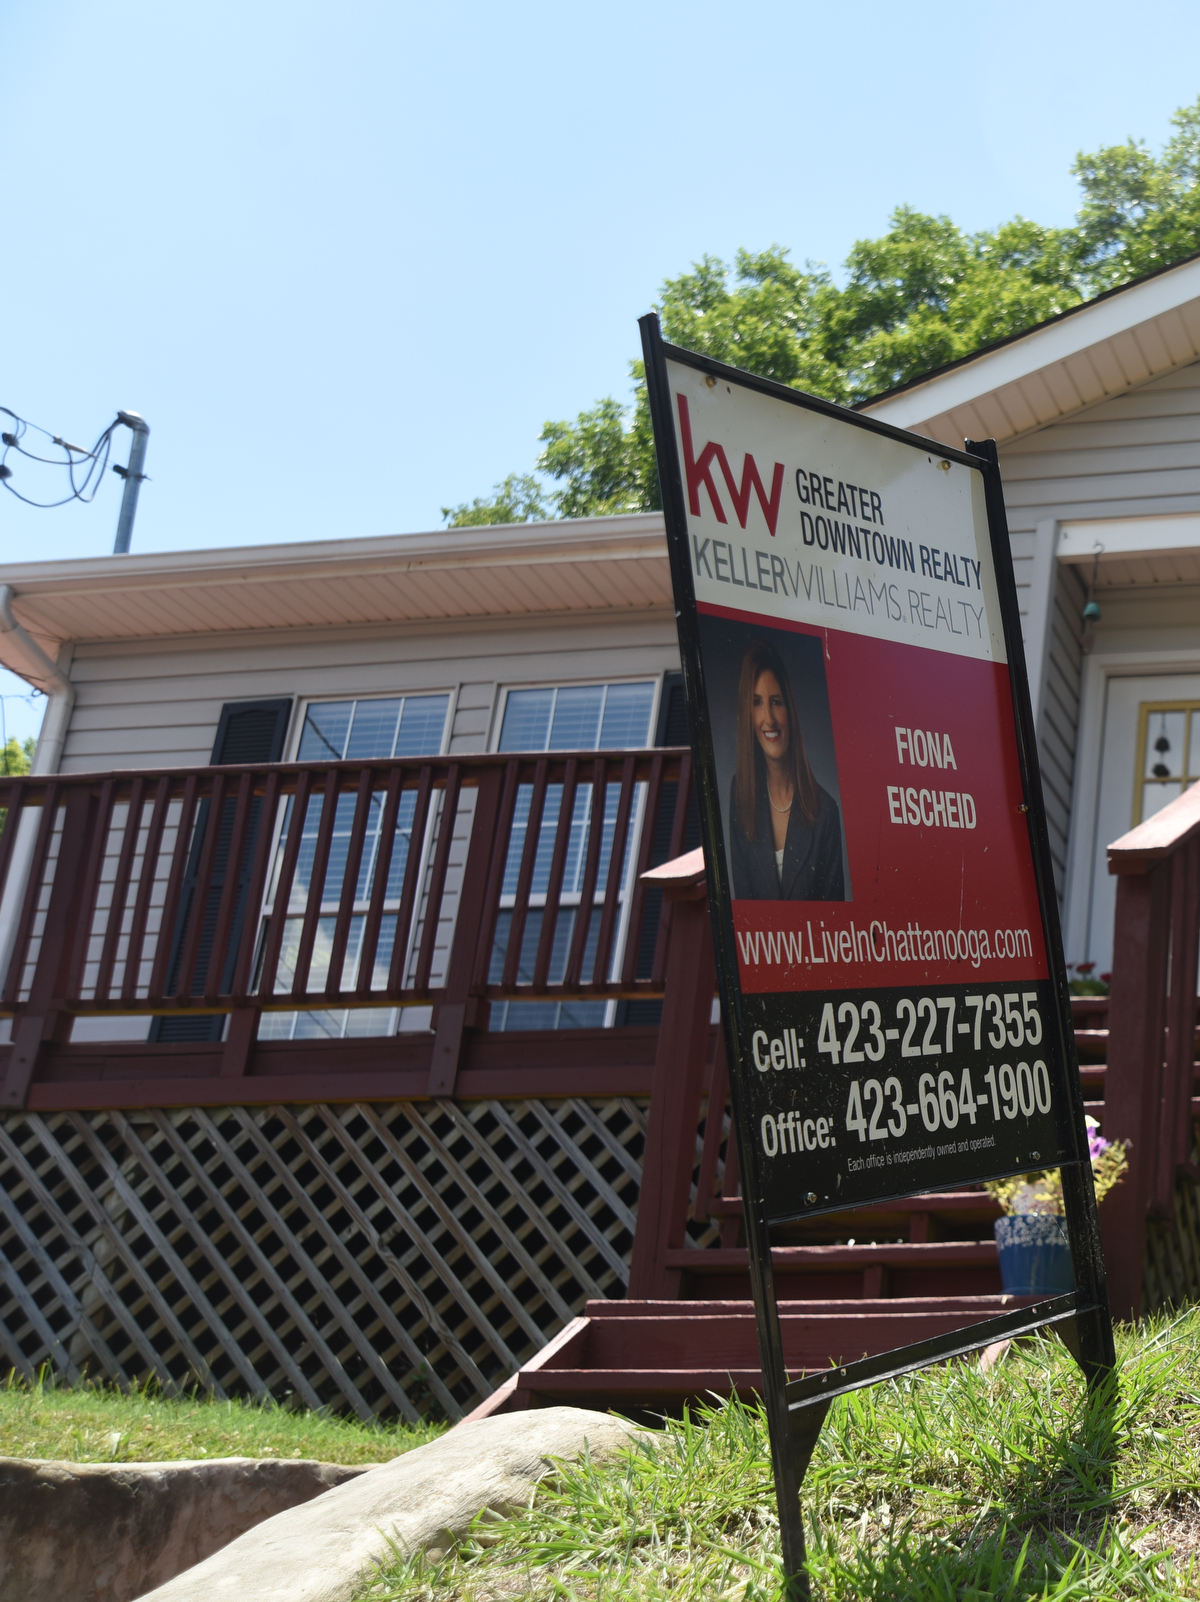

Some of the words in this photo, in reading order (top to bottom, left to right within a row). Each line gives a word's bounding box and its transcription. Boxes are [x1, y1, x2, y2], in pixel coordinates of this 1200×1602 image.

[795, 468, 884, 526] GREATER
[800, 511, 916, 574] DOWNTOWN
[919, 544, 982, 591] REALTY
[908, 589, 984, 639] REALTY
[894, 726, 958, 771] FIONA
[886, 785, 978, 830] EISCHEID
[737, 920, 1034, 969] www.LiveInChattanooga.com
[752, 1029, 807, 1073] Cell:
[817, 991, 1043, 1065] 423-227-7355
[760, 1111, 837, 1158] Office:
[845, 1059, 1052, 1143] 423-664-1900
[847, 1156, 865, 1172] Each
[866, 1154, 885, 1169] office
[886, 1151, 893, 1165] is
[893, 1144, 936, 1164] independently
[936, 1140, 957, 1156] owned
[957, 1138, 969, 1153] and
[969, 1134, 997, 1152] operated.
